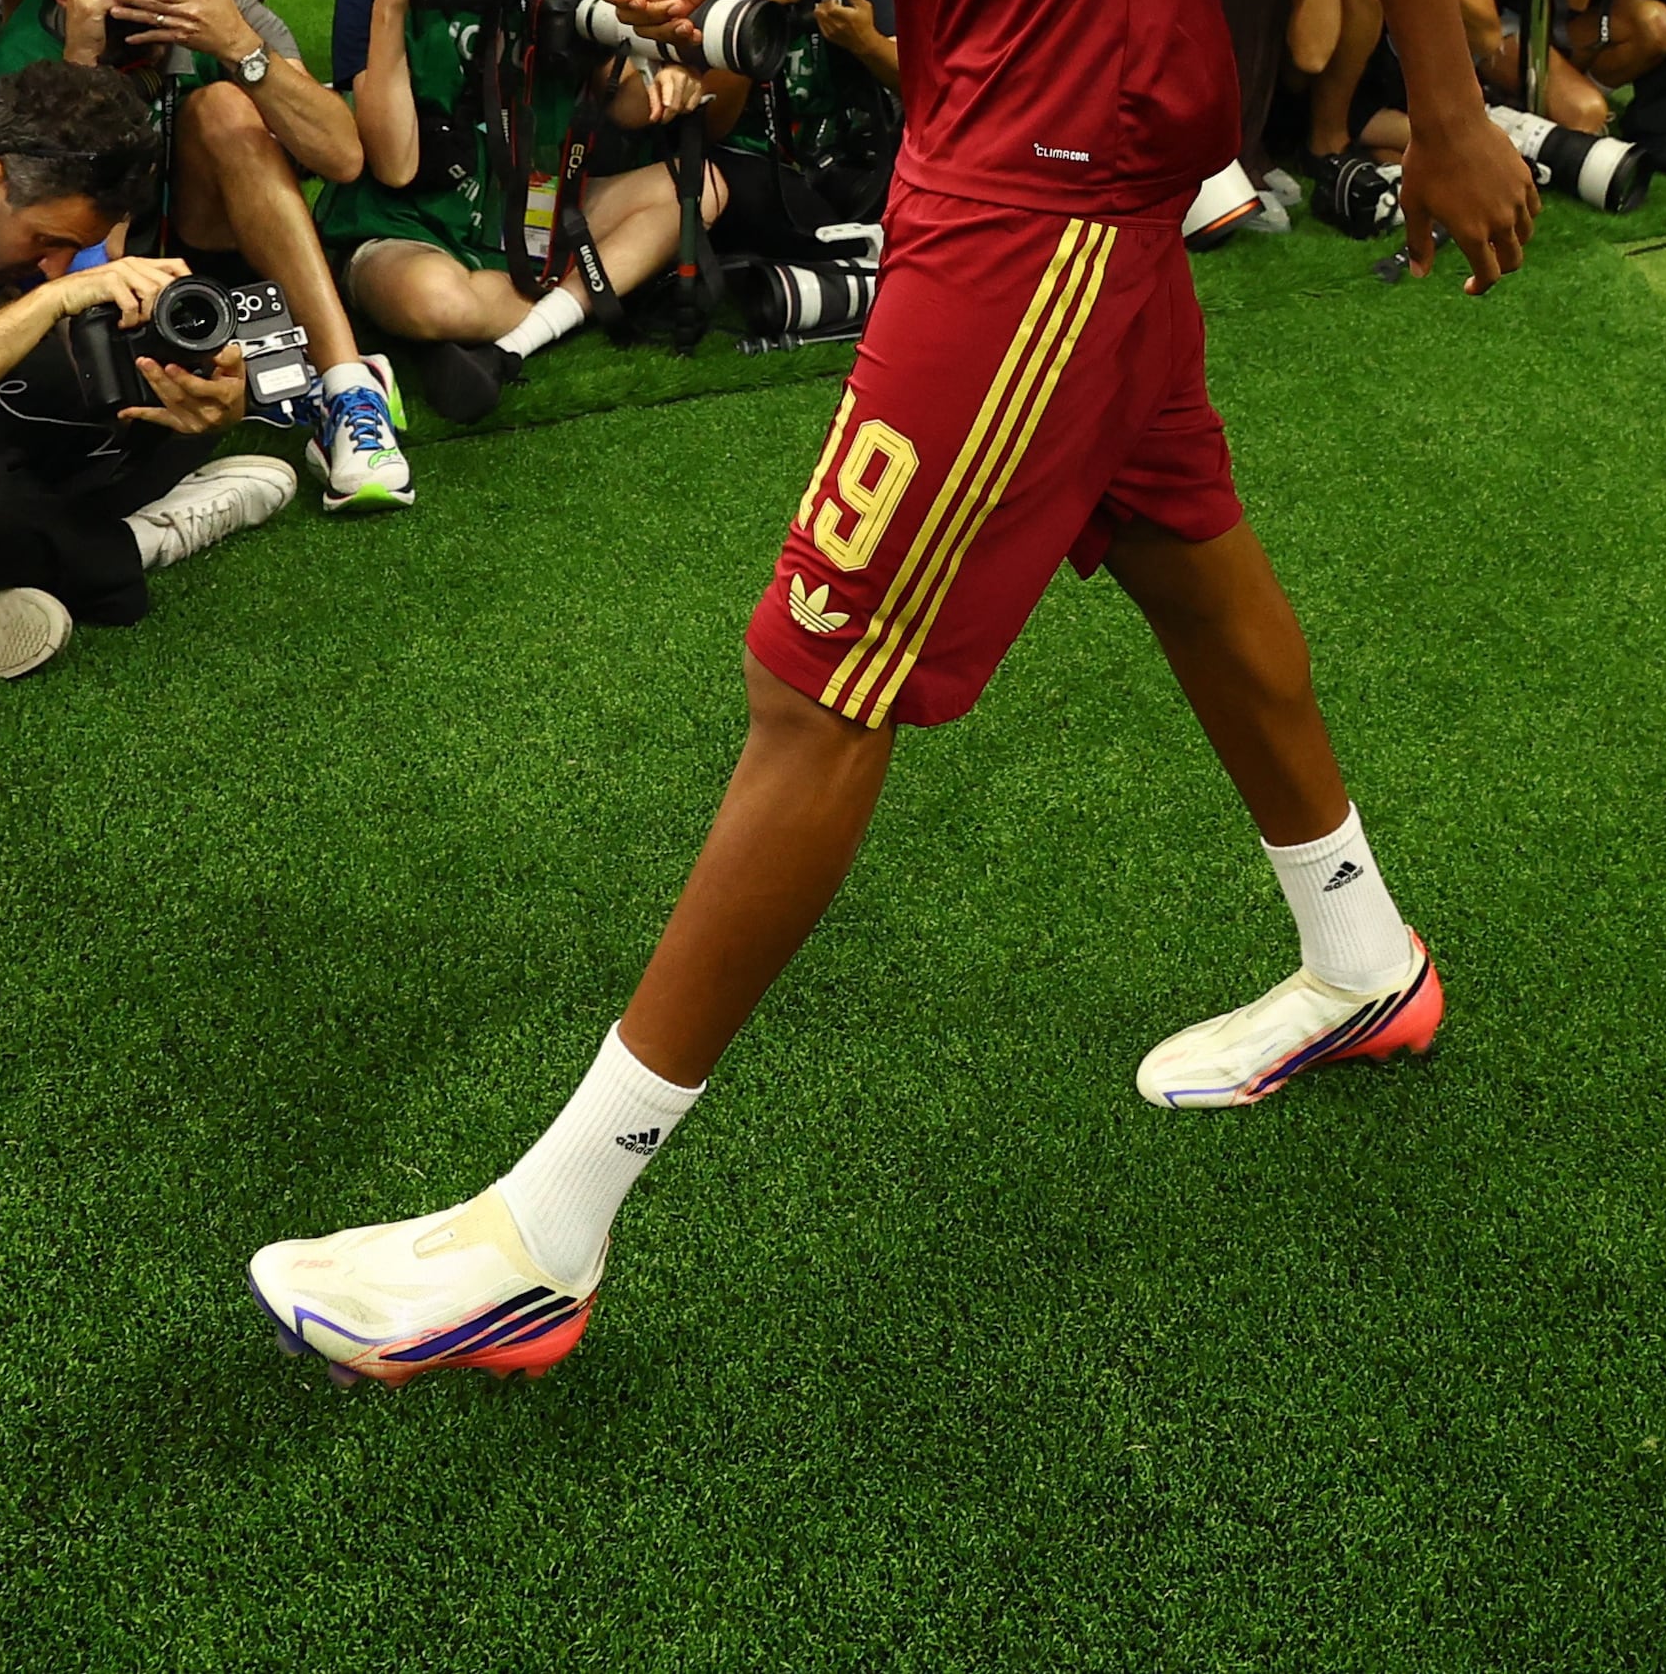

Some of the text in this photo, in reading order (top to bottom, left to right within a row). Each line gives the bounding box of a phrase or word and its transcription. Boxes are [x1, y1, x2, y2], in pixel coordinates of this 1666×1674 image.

[1035, 144, 1090, 163] CLIMACOOL
[580, 243, 604, 284] Canon
[798, 384, 921, 574] 19
[1322, 865, 1364, 893] adidas
[615, 1134, 659, 1156] adidas
